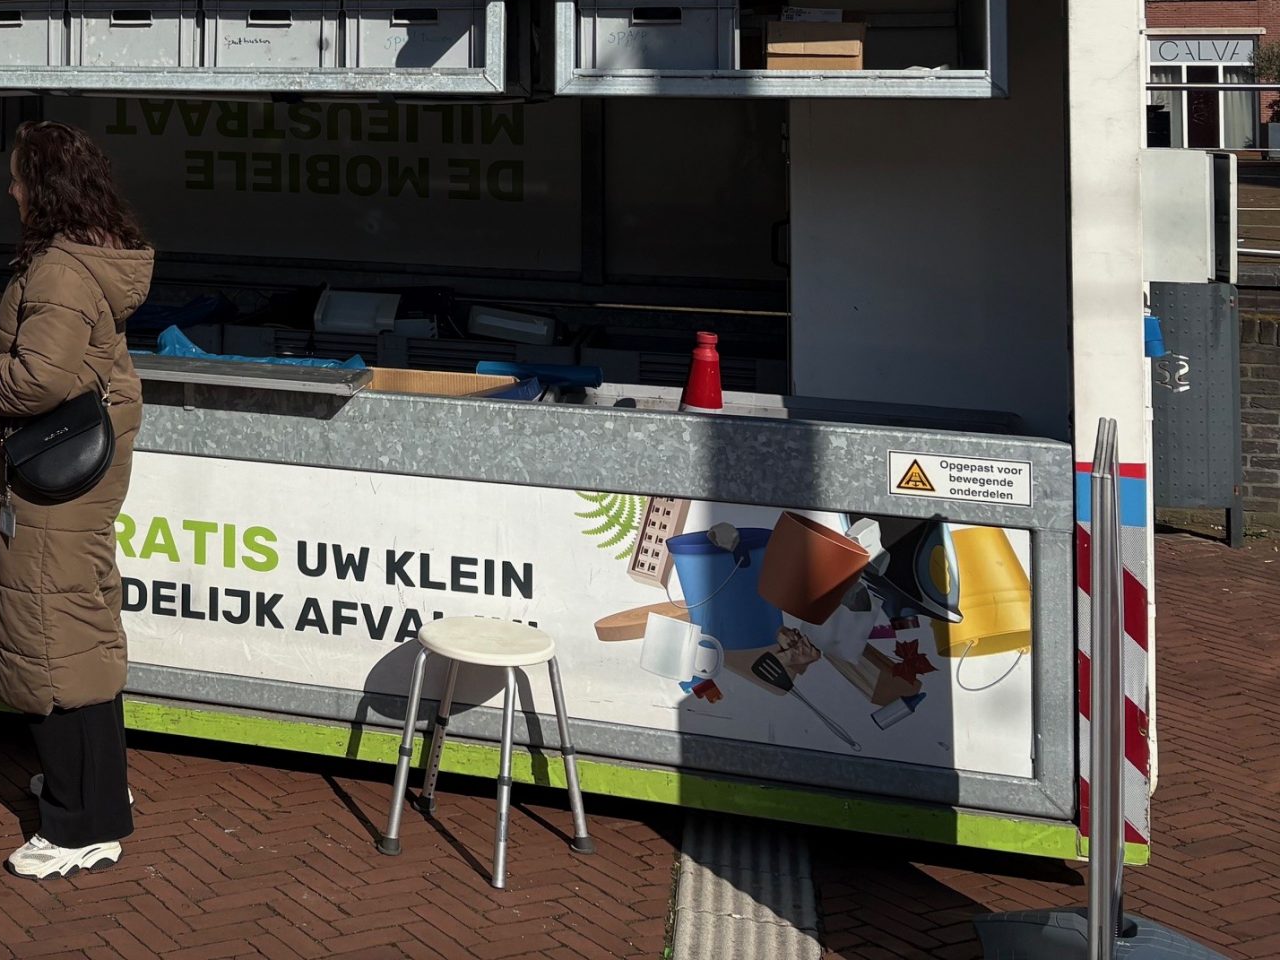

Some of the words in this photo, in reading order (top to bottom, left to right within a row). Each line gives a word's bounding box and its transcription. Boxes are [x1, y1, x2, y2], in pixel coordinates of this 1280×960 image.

[1158, 40, 1240, 61] CALVA
[106, 97, 526, 145] MILIEUSTRAAT
[185, 150, 430, 199] MOBIELE
[448, 158, 525, 202] DE
[939, 460, 994, 473] Opgepast
[997, 466, 1023, 475] voor
[949, 474, 1014, 487] bewegende
[949, 487, 1013, 500] onderdelen
[114, 513, 279, 572] RATIS
[297, 540, 370, 582] UW
[385, 549, 533, 600] KLEIN
[120, 576, 284, 629] DELIJK
[295, 596, 443, 643] AFVA
